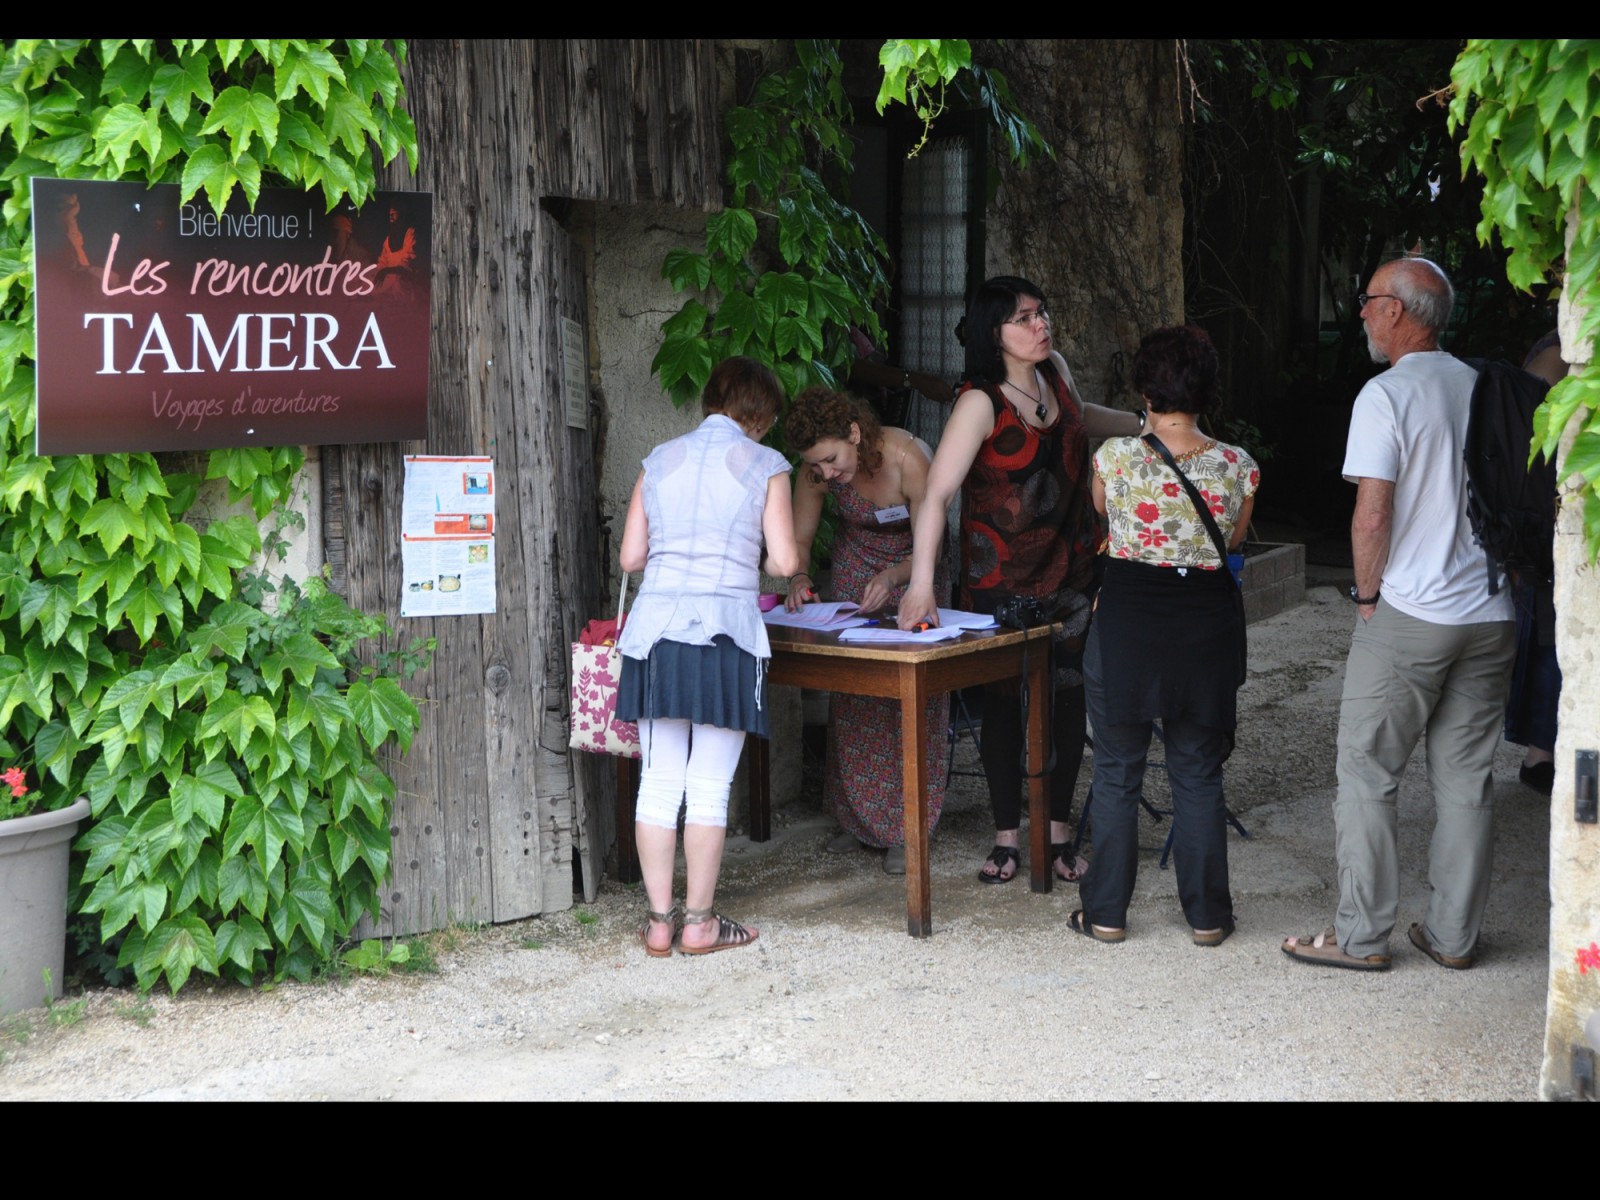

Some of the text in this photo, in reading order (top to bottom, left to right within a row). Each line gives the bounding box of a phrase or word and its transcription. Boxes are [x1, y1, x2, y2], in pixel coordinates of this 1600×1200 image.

[179, 204, 299, 239] Bienvenue
[101, 232, 378, 297] Les rencontres
[83, 311, 396, 375] TAMERA
[152, 385, 341, 432] Voyages d'aventures
